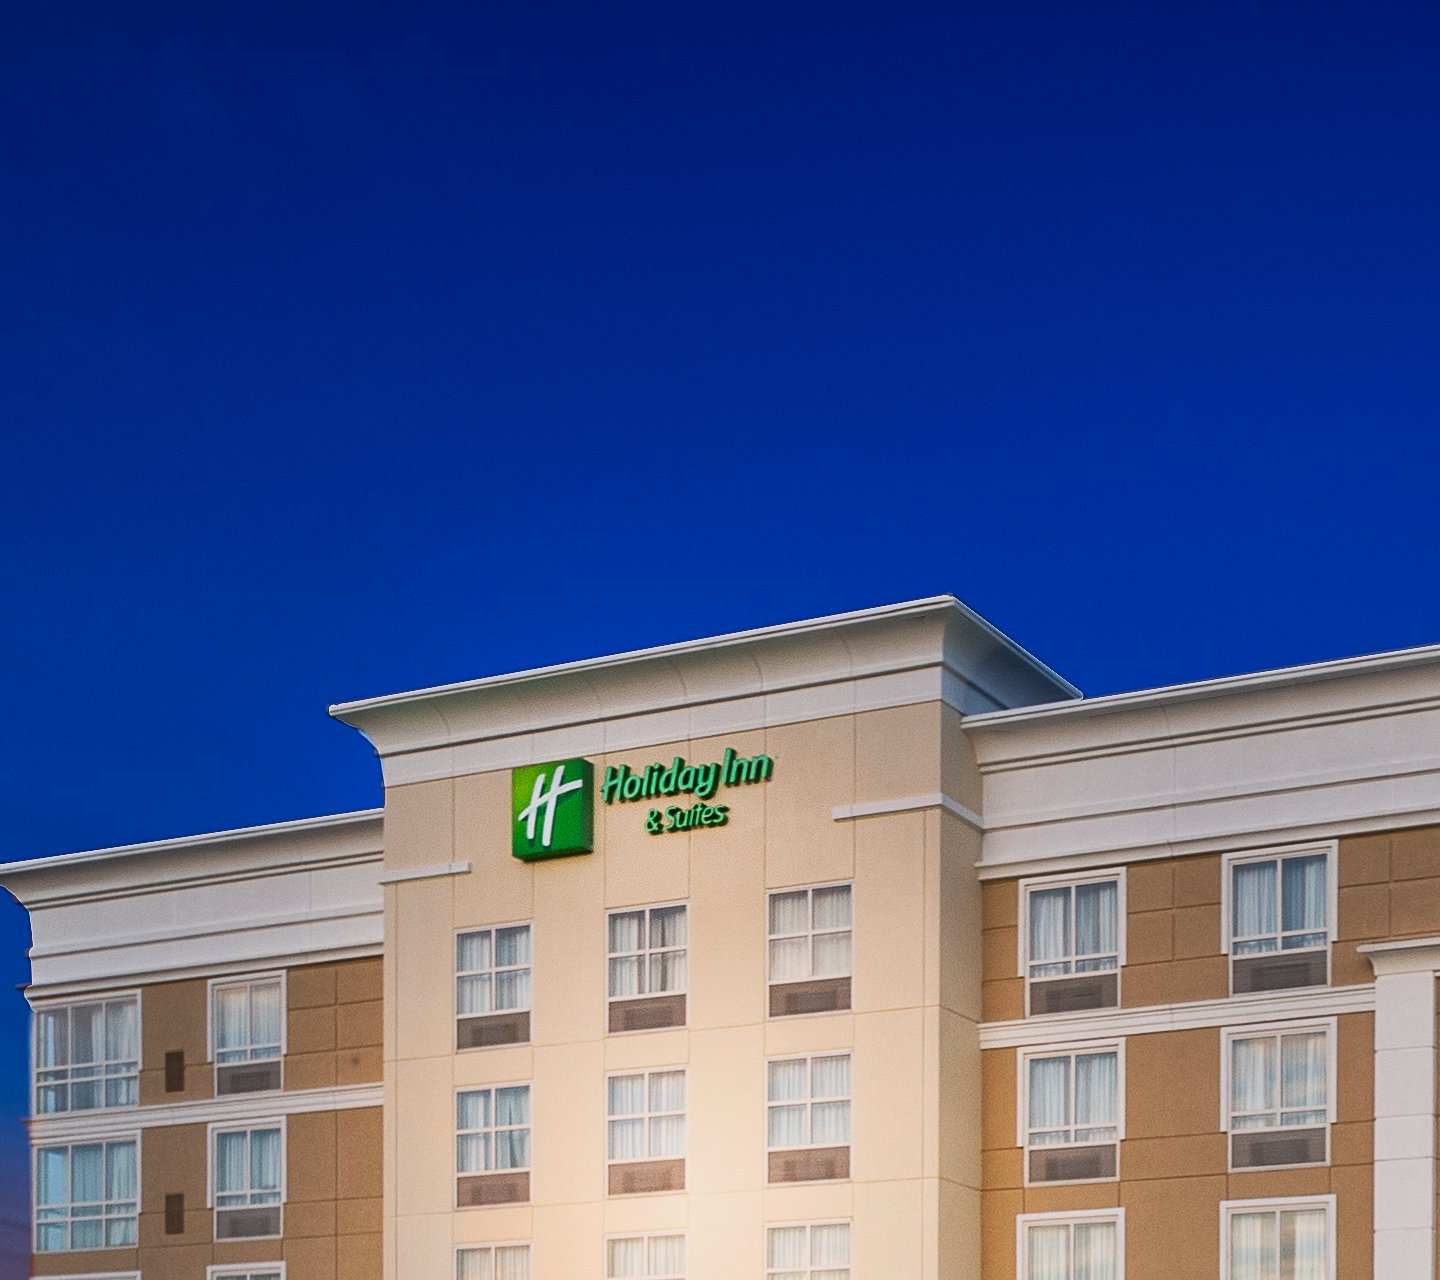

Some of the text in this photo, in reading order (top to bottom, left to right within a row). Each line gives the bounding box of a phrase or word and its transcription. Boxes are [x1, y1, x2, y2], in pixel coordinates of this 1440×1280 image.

[601, 747, 773, 803] Holiday Inn
[644, 803, 729, 834] & Suites
